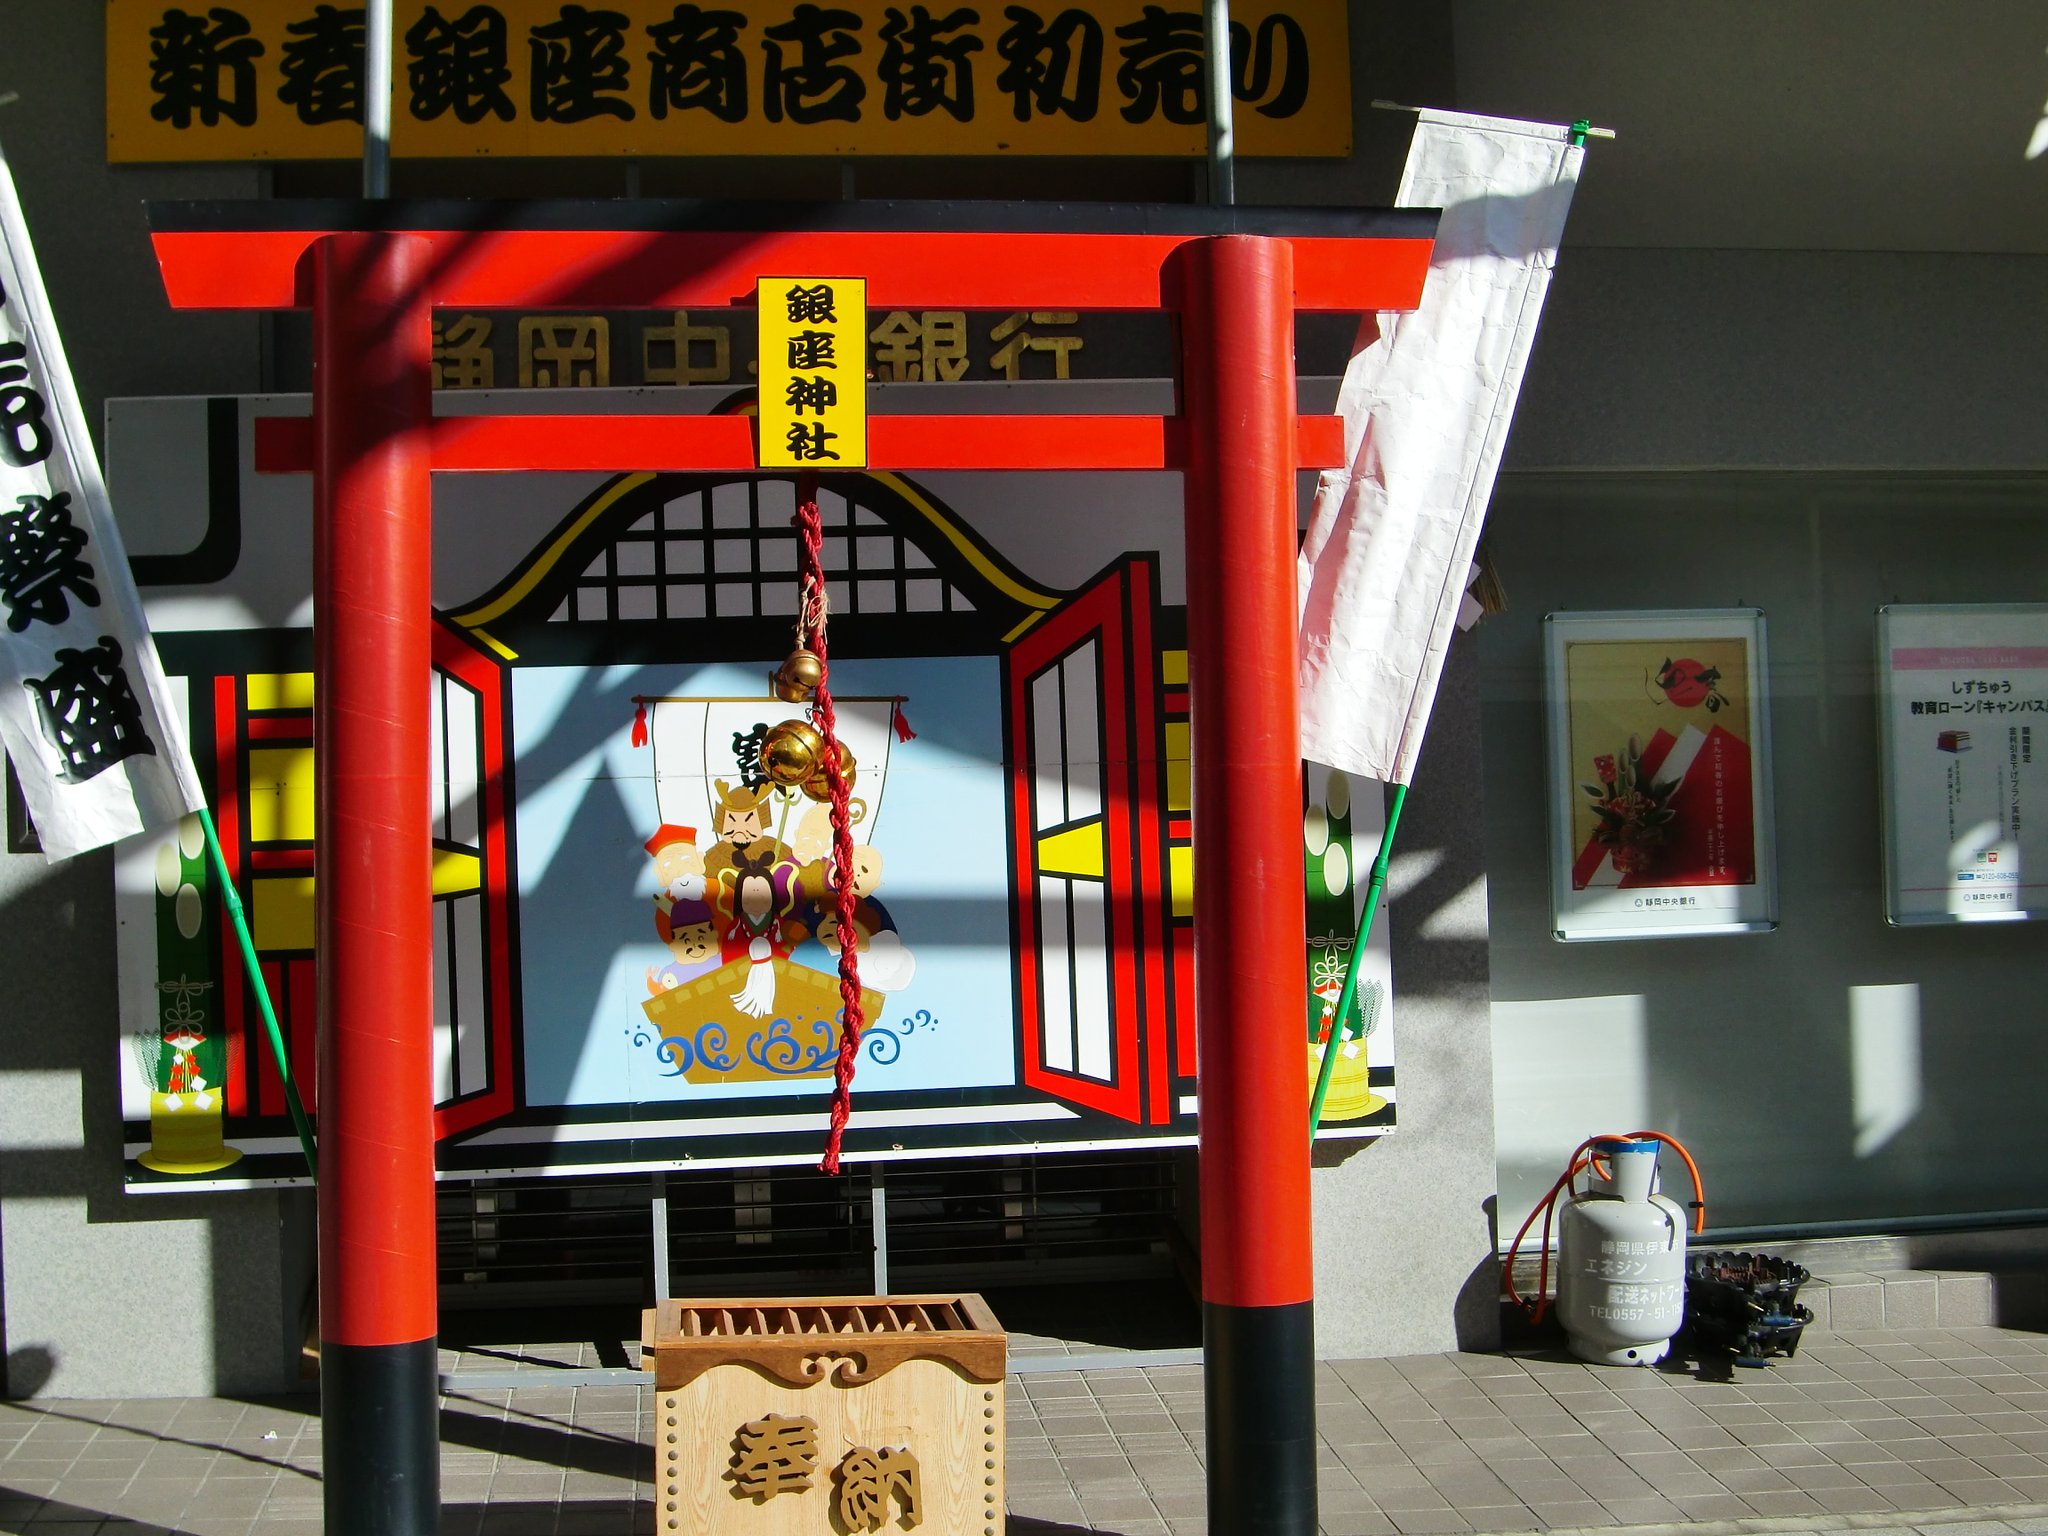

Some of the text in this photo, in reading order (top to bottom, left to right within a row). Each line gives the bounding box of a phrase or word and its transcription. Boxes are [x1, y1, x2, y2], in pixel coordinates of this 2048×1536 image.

[150, 4, 1309, 128] 新春銀座商店街初売り
[432, 310, 1084, 388] 静岡中銀行
[785, 283, 841, 461] 銀座神社
[1952, 679, 2012, 695] しずちゅう
[1584, 1258, 1648, 1276] エネジン
[727, 1411, 924, 1535] 奉納
